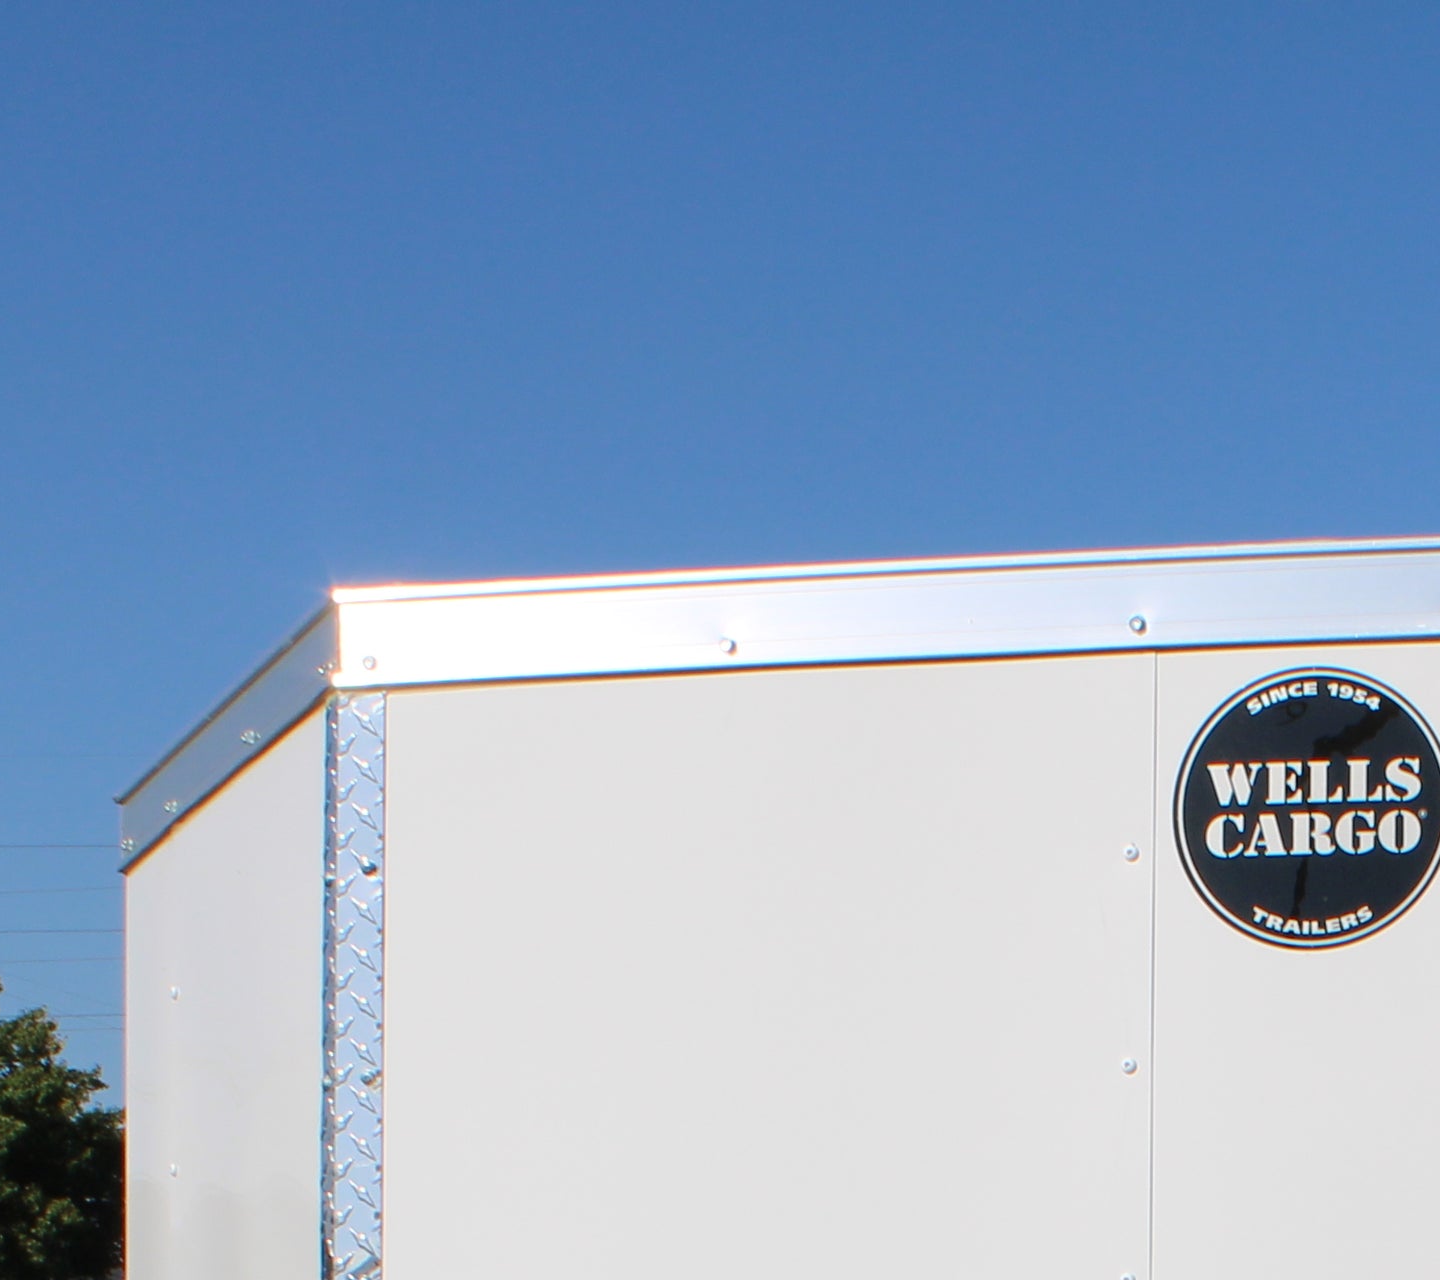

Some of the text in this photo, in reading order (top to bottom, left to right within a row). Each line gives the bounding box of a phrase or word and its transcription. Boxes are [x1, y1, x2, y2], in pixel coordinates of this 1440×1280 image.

[1246, 681, 1382, 716] SINCE 1954
[1206, 756, 1422, 806] WELLS
[1205, 809, 1422, 858] CARGO
[1253, 905, 1374, 935] TRAILERS
